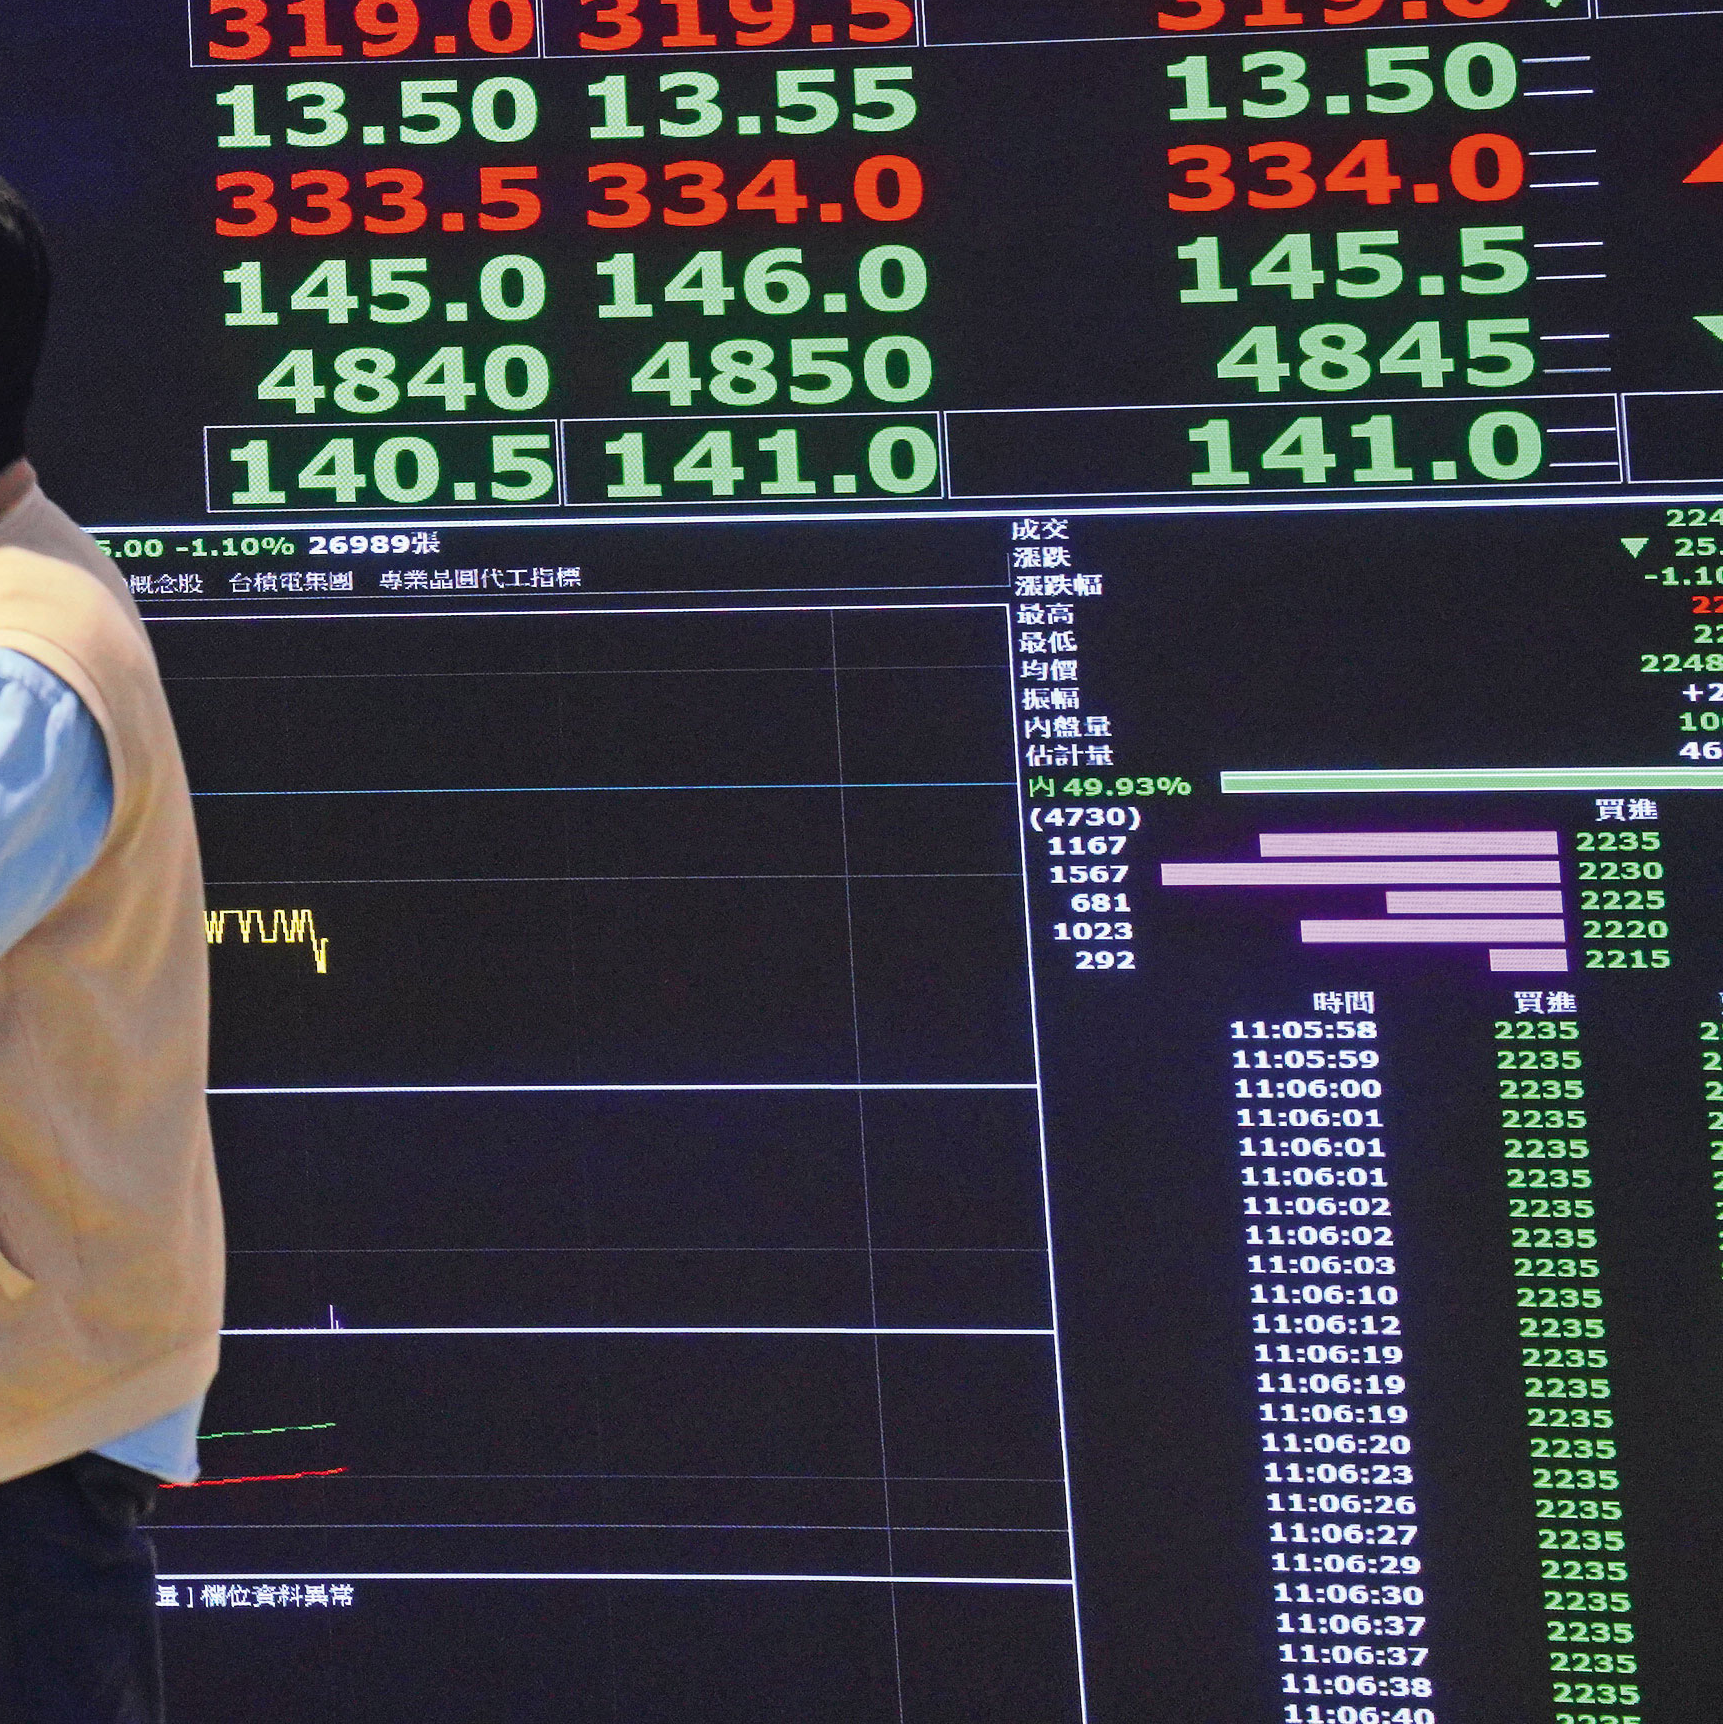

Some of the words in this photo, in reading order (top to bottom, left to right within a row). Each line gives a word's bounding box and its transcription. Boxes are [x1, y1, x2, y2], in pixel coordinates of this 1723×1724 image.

[215, 165, 542, 238] 333.5
[586, 154, 925, 229] 334.0
[1167, 132, 1525, 213] 334.0
[222, 254, 547, 327] 145.0
[596, 244, 928, 319] 146.0
[1177, 225, 1530, 304] 145.5
[257, 343, 551, 415] 4840
[630, 334, 933, 407] 4850
[1216, 317, 1536, 393] 4845
[229, 433, 555, 505] 140.5
[604, 425, 938, 498] 141.0
[1188, 410, 1543, 486] 141.0
[1012, 517, 1070, 541] 成交
[175, 536, 295, 557] -1.10%
[1012, 546, 1072, 569] 漲跌
[1018, 630, 1078, 654] 最低
[1061, 776, 1193, 797] 49.93%
[1030, 806, 1141, 832] (4730)
[1048, 835, 1127, 856] 1167
[1575, 831, 1661, 852] 2235
[1071, 892, 1131, 913] 681
[1580, 889, 1666, 911] 2225
[1313, 991, 1375, 1015] 時間
[1514, 991, 1577, 1015] 買進
[1230, 1020, 1378, 1039] 11:05:58
[1494, 1020, 1580, 1040] 2235
[1250, 1283, 1399, 1306] 11:06:10
[1516, 1287, 1603, 1309] 2235
[1281, 1672, 1433, 1698] 11:06:38
[1552, 1681, 1641, 1706] 2235
